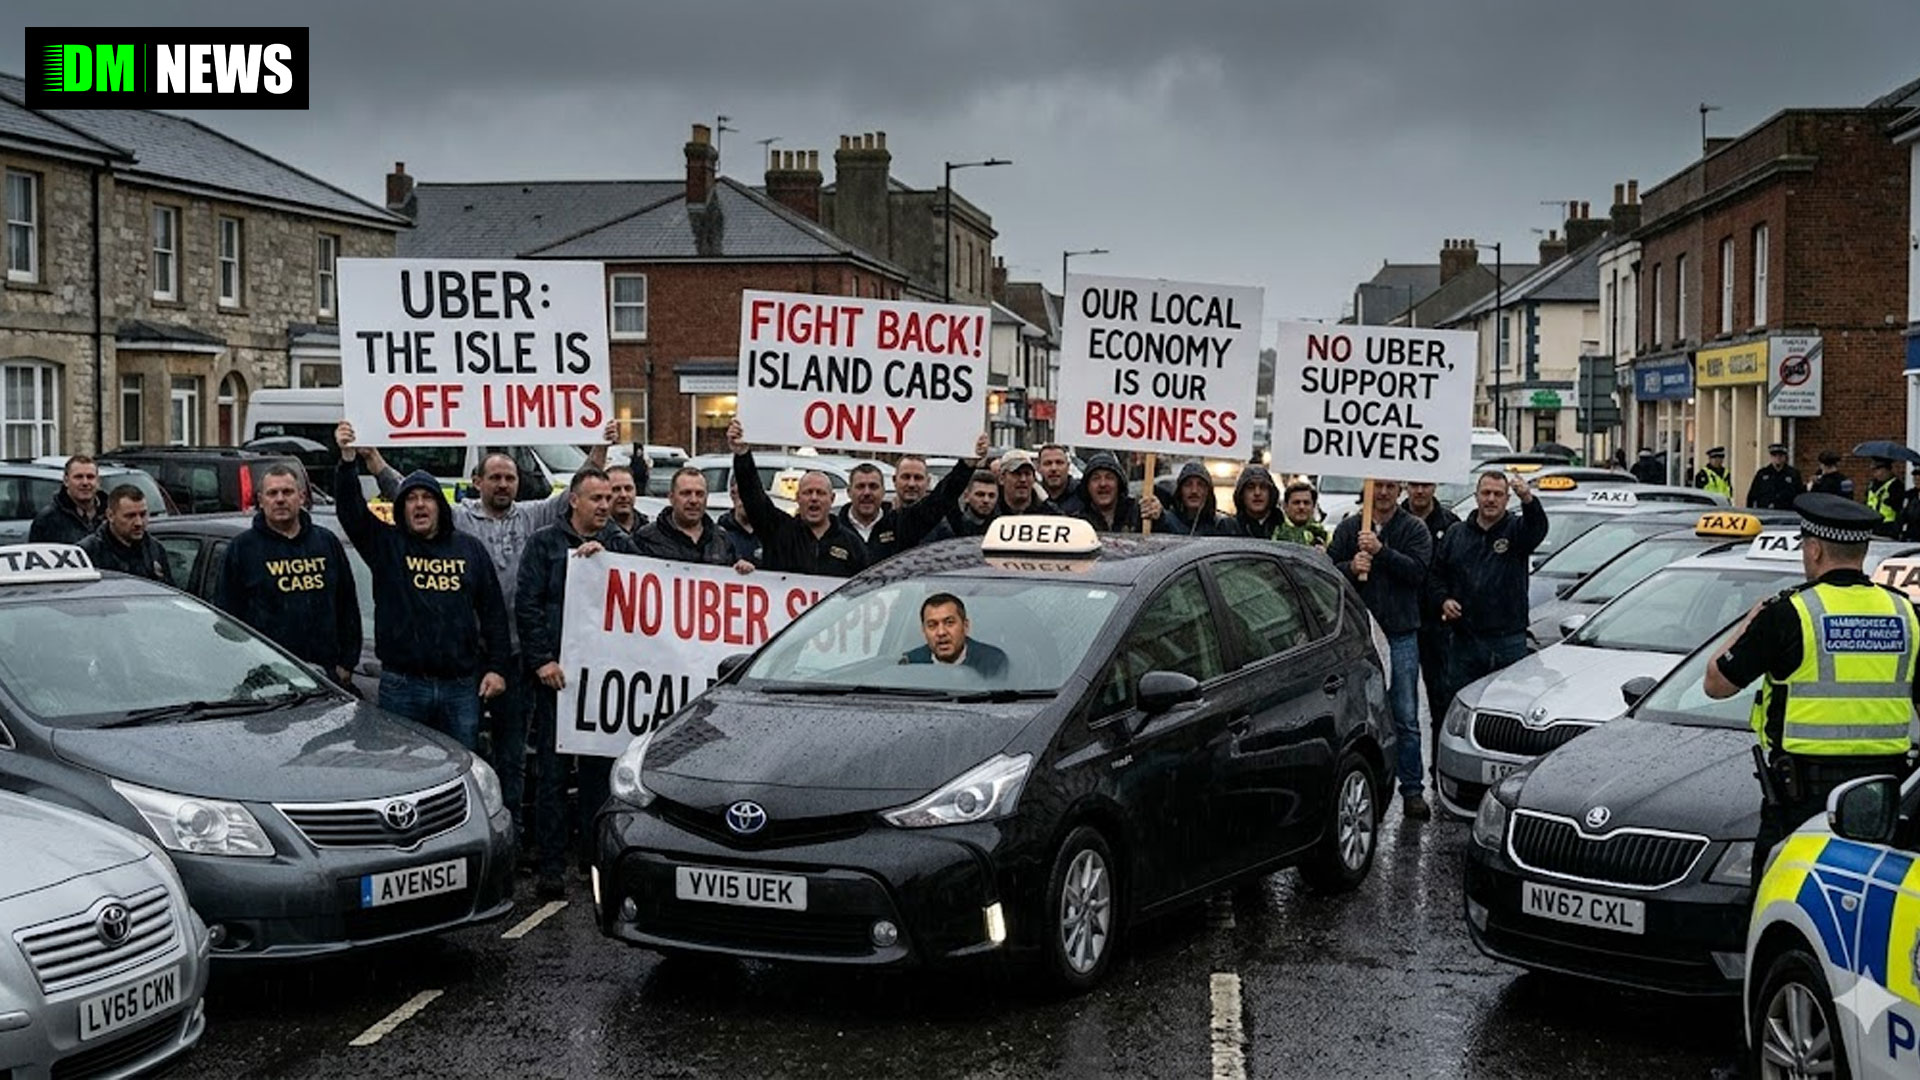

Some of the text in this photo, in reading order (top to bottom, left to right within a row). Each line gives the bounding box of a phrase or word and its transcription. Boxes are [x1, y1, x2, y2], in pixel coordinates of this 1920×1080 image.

[401, 270, 550, 319] UBER:
[1082, 288, 1241, 329] OUR LOCAL
[750, 300, 983, 358] FIGHT BACK!
[357, 331, 590, 374] THE ISLE IS
[1089, 328, 1232, 368] ECONOMY
[1308, 336, 1454, 372] NO UBER,
[748, 350, 974, 403] ISLAND CABS
[1115, 369, 1206, 401] IS OUR
[1301, 366, 1438, 399] SUPPORT
[384, 384, 602, 428] OFF LIMITS
[804, 401, 915, 445] ONLY
[1086, 401, 1237, 447] BUSINESS
[1324, 400, 1422, 429] LOCAL
[1303, 428, 1439, 463] DRIVERS
[1591, 490, 1628, 502] TAXI
[1000, 524, 1070, 543] UBER
[1702, 515, 1748, 531] TAXI
[0, 549, 88, 572] TAXI
[266, 557, 326, 577] WIGHT
[406, 556, 466, 574] WIGHT
[277, 574, 324, 592] CABS
[413, 574, 461, 591] CABS
[604, 568, 663, 637] NO
[674, 577, 770, 645] UBER
[381, 864, 457, 900] AVENSC
[689, 872, 792, 904] YV15 UEK
[1531, 887, 1633, 928] NV62 CXL
[88, 987, 137, 1032] LV65
